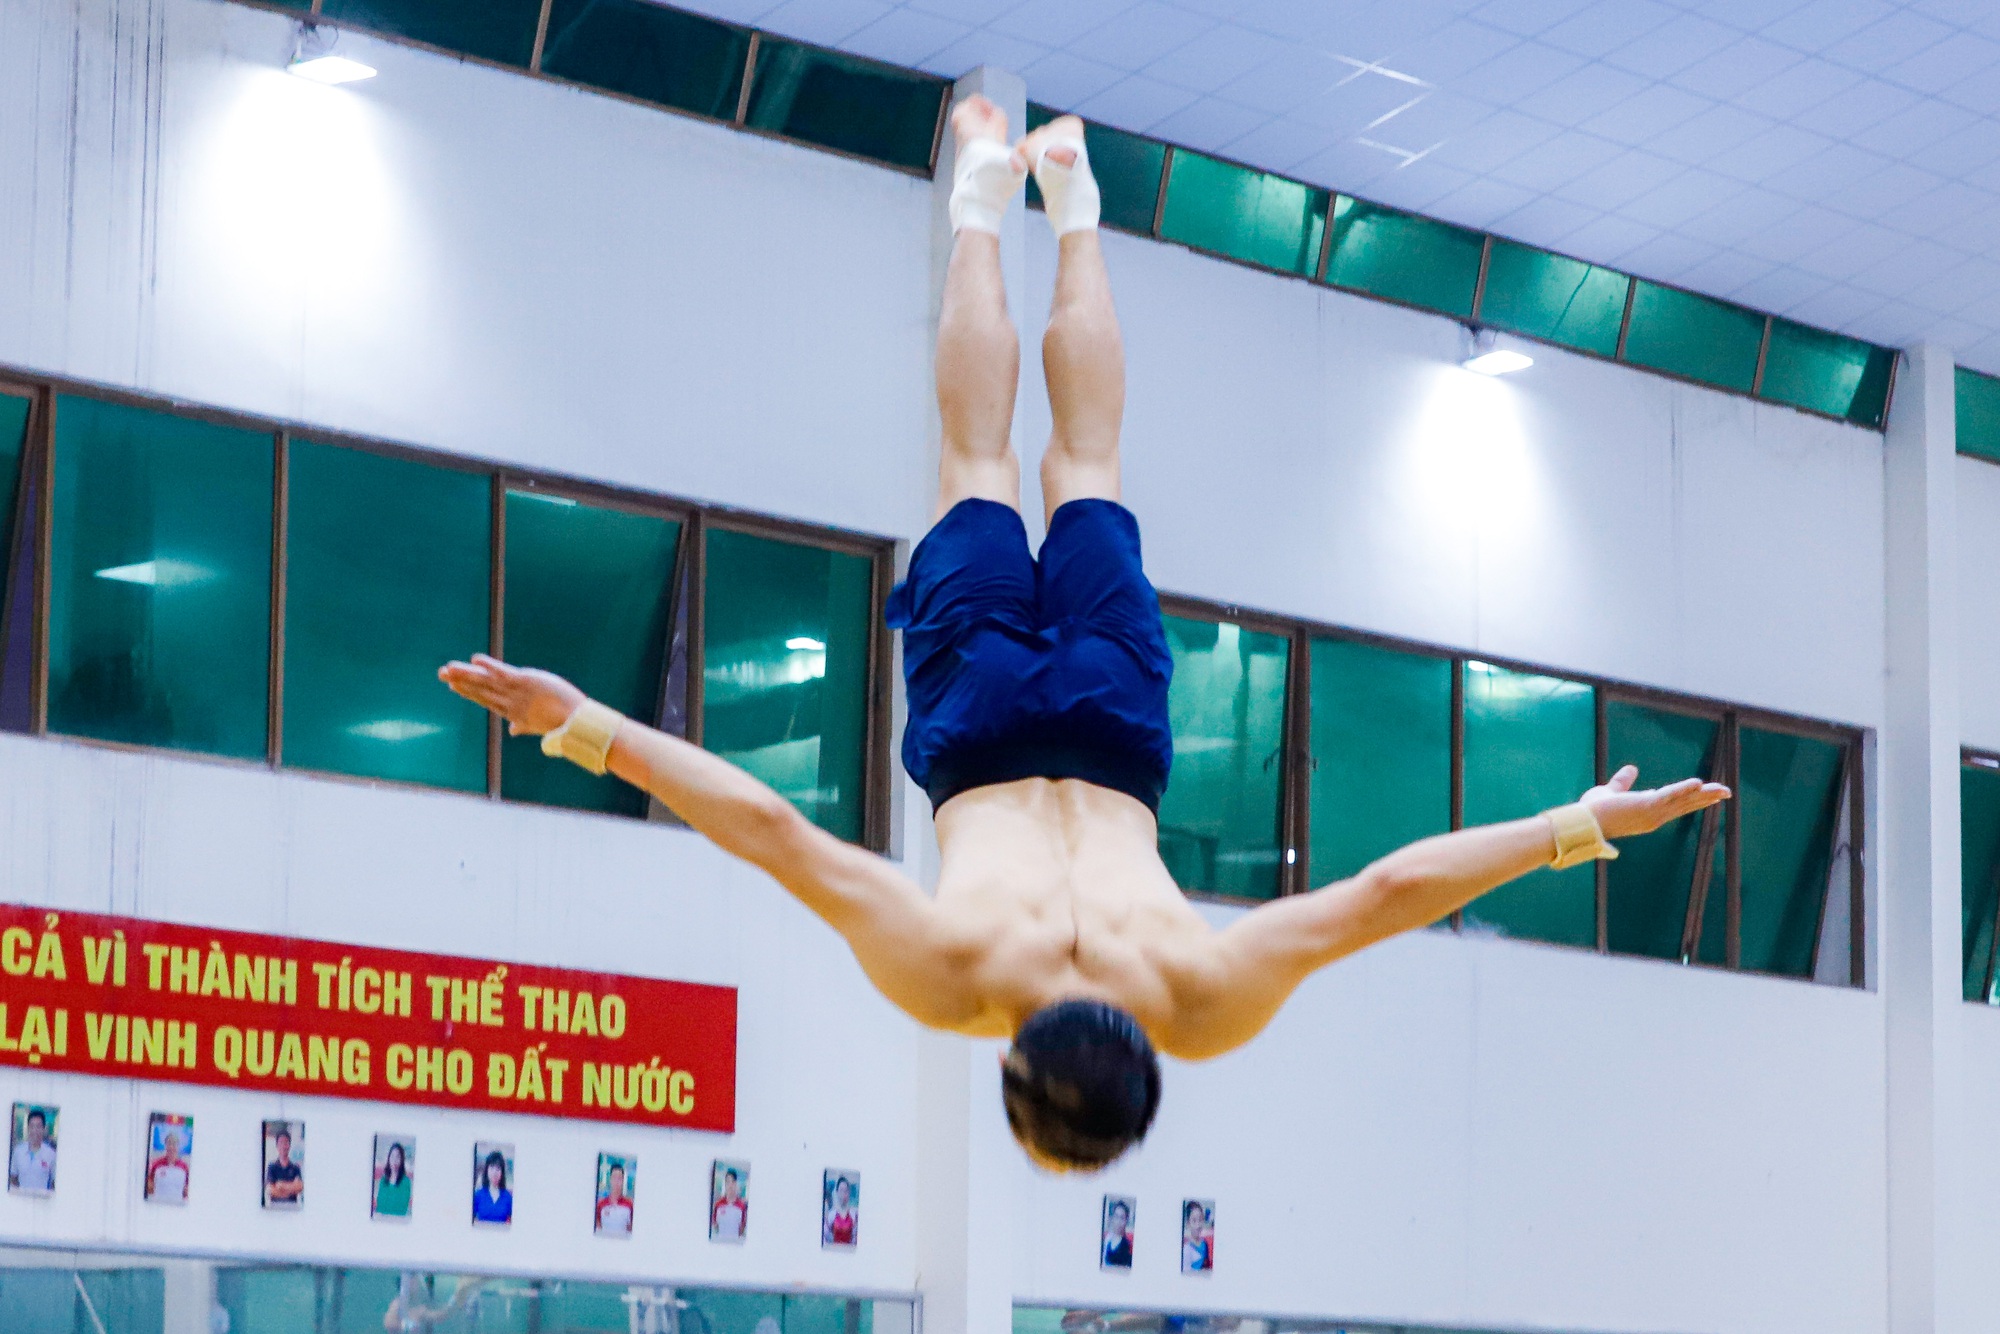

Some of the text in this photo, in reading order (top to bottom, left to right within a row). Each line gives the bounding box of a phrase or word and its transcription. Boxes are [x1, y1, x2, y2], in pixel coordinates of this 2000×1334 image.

[1, 912, 626, 1039] CẢ VÌ THÀNH TÍCH THỂ THAO
[0, 1003, 695, 1114] LẠI VINH QUANG CHO ĐẤT NƯỚC
